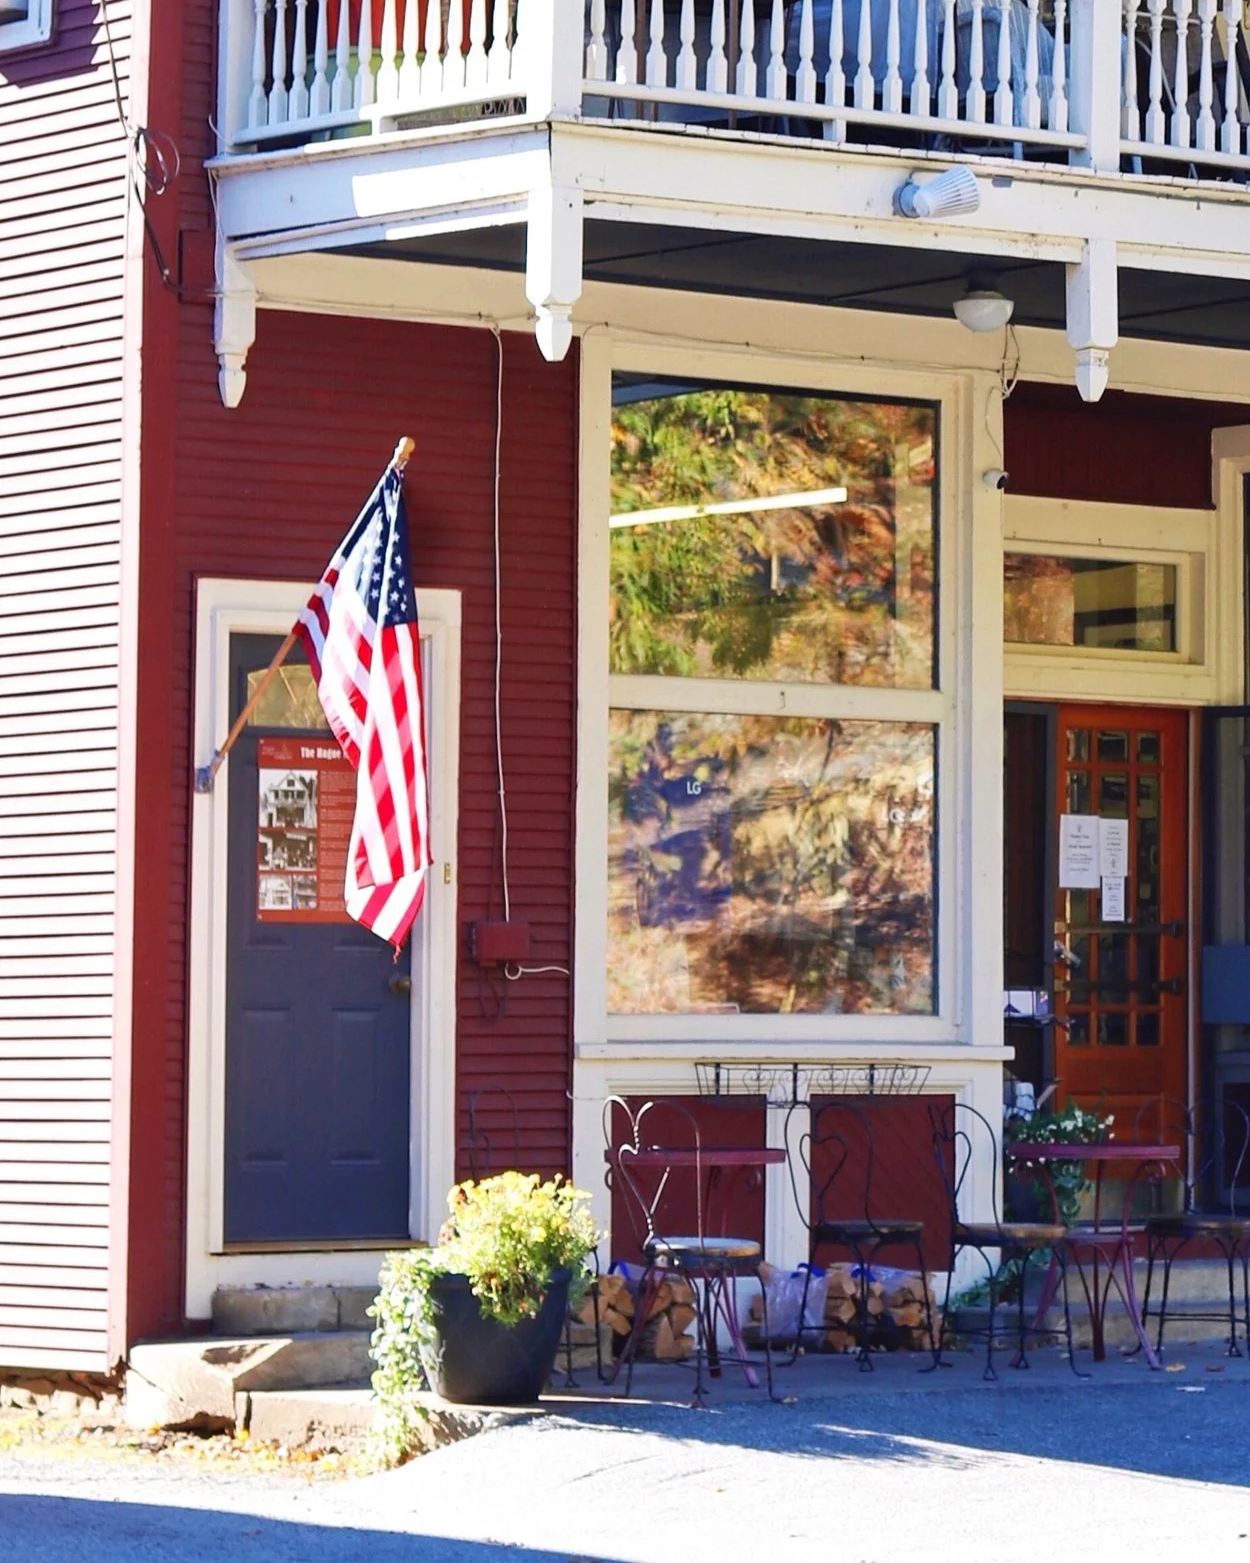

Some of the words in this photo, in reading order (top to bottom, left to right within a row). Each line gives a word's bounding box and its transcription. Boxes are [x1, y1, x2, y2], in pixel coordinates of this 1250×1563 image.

[300, 746, 315, 759] The
[316, 746, 341, 760] Hague
[686, 780, 702, 795] LG
